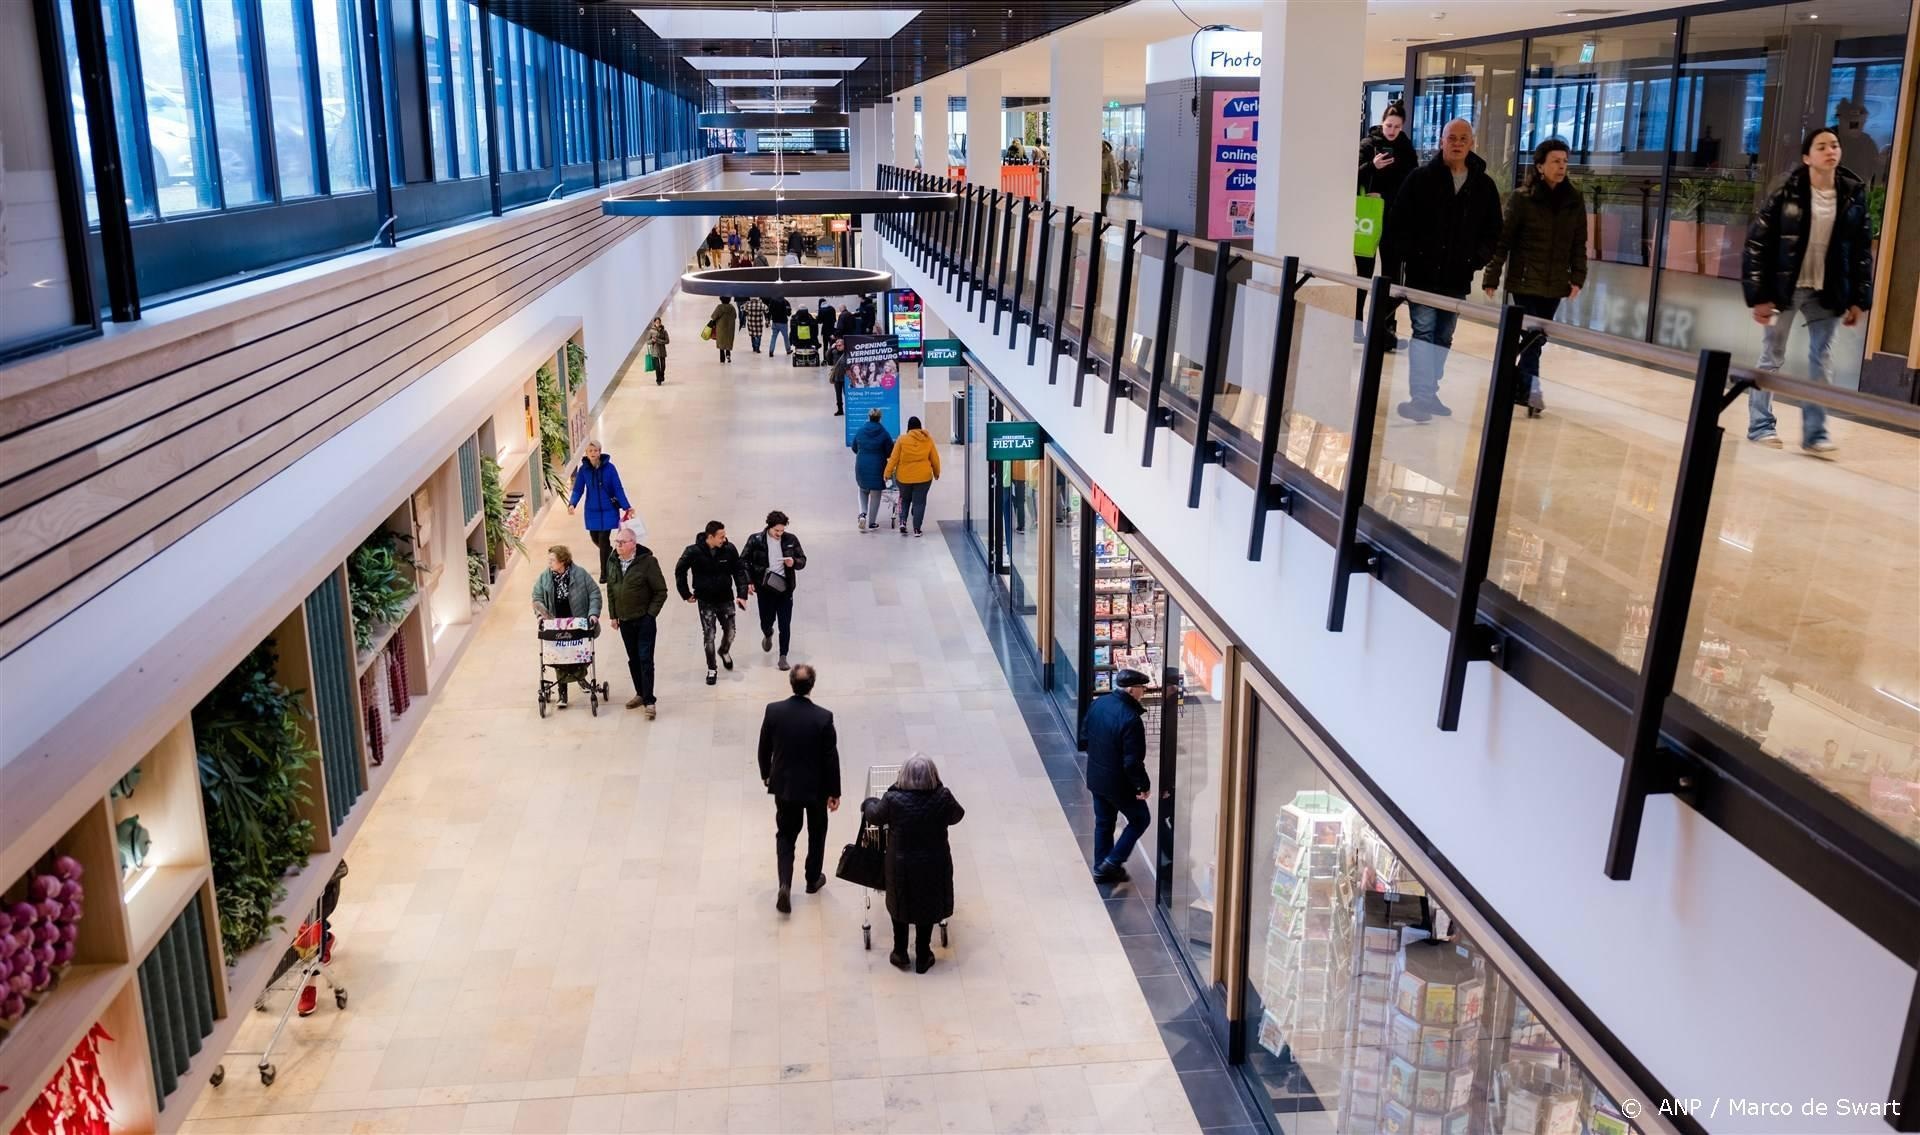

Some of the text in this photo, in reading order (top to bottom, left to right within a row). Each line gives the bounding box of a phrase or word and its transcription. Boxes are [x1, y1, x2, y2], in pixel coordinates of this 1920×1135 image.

[1210, 51, 1262, 68] Photo
[1233, 99, 1259, 113] Verl
[854, 341, 888, 350] OPENING
[850, 347, 893, 358] VERNIEUWD
[846, 353, 898, 365] STERRENBURG
[992, 439, 1034, 449] PIET LAP
